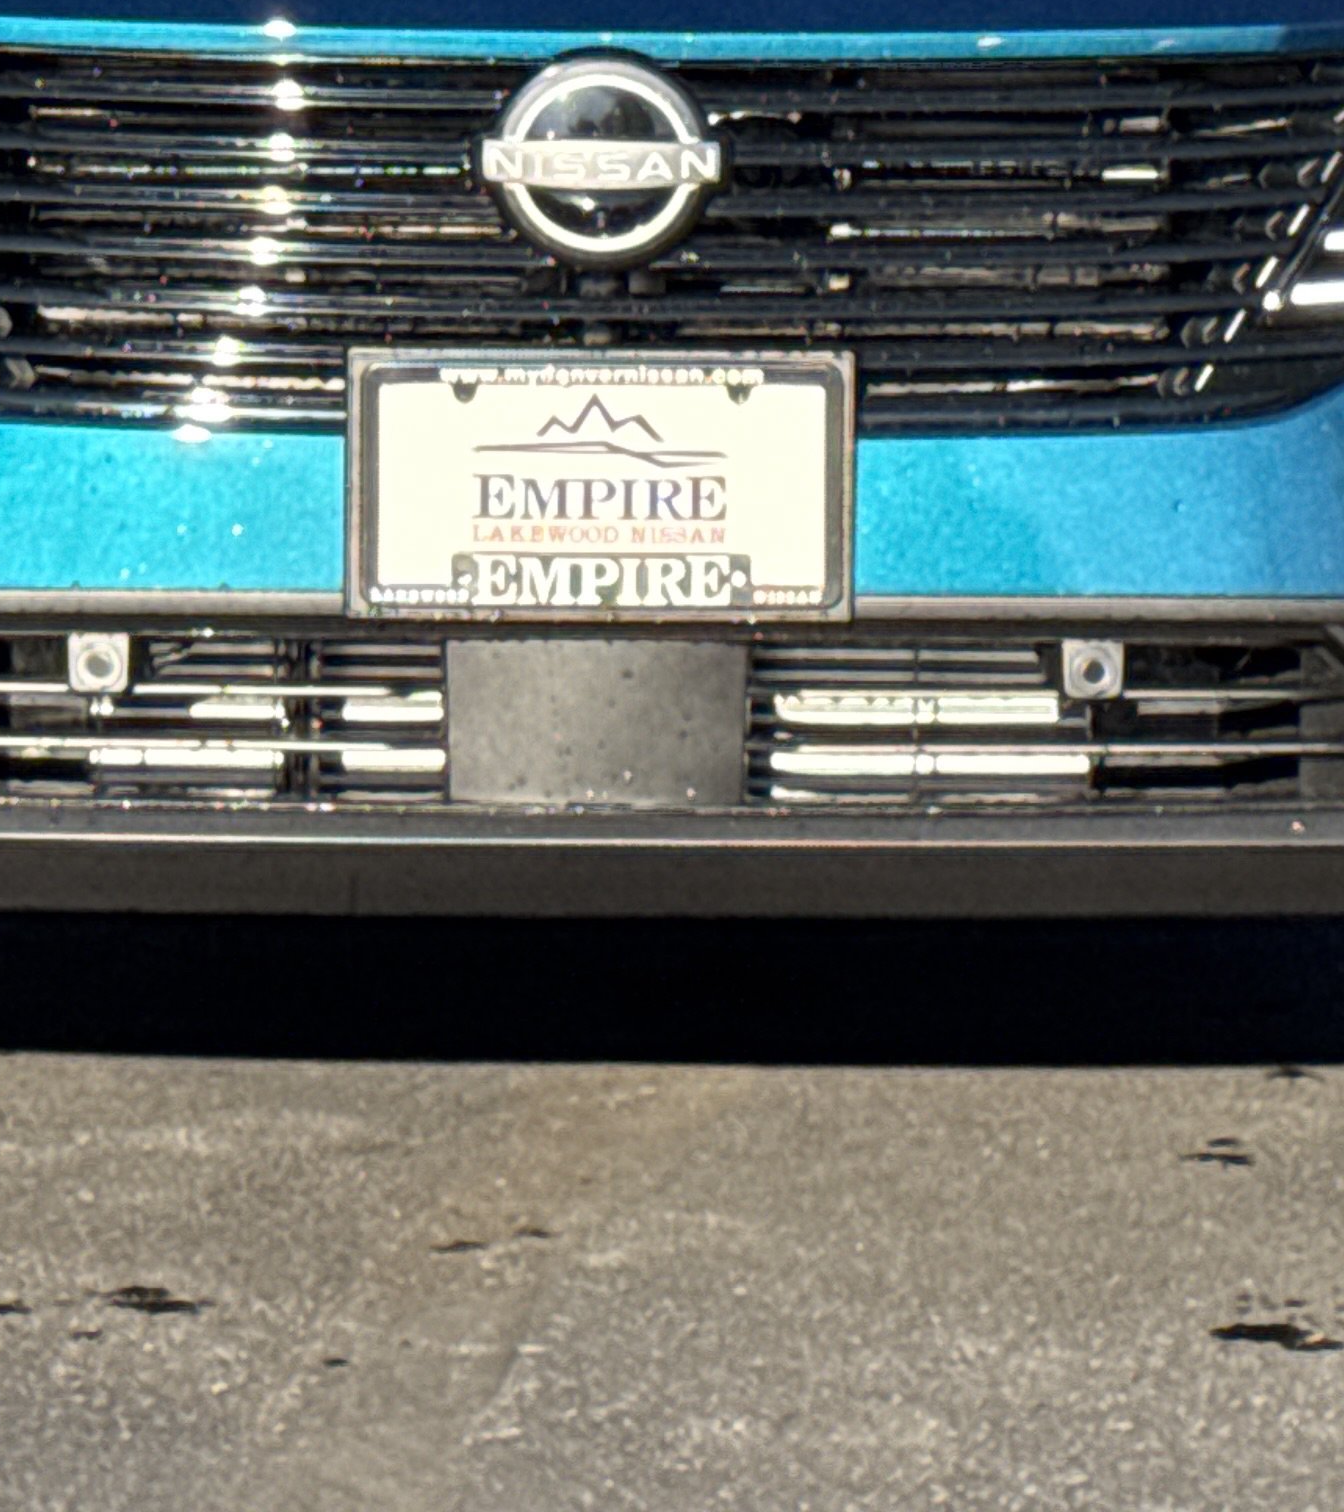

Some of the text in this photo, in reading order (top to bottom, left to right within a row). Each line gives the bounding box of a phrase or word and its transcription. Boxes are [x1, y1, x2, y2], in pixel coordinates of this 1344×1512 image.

[489, 146, 718, 182] NISSAN
[473, 473, 727, 521] EMPIRE
[472, 524, 726, 545] LAKEWOOD NISSAN
[472, 554, 731, 607] EMPIRE
